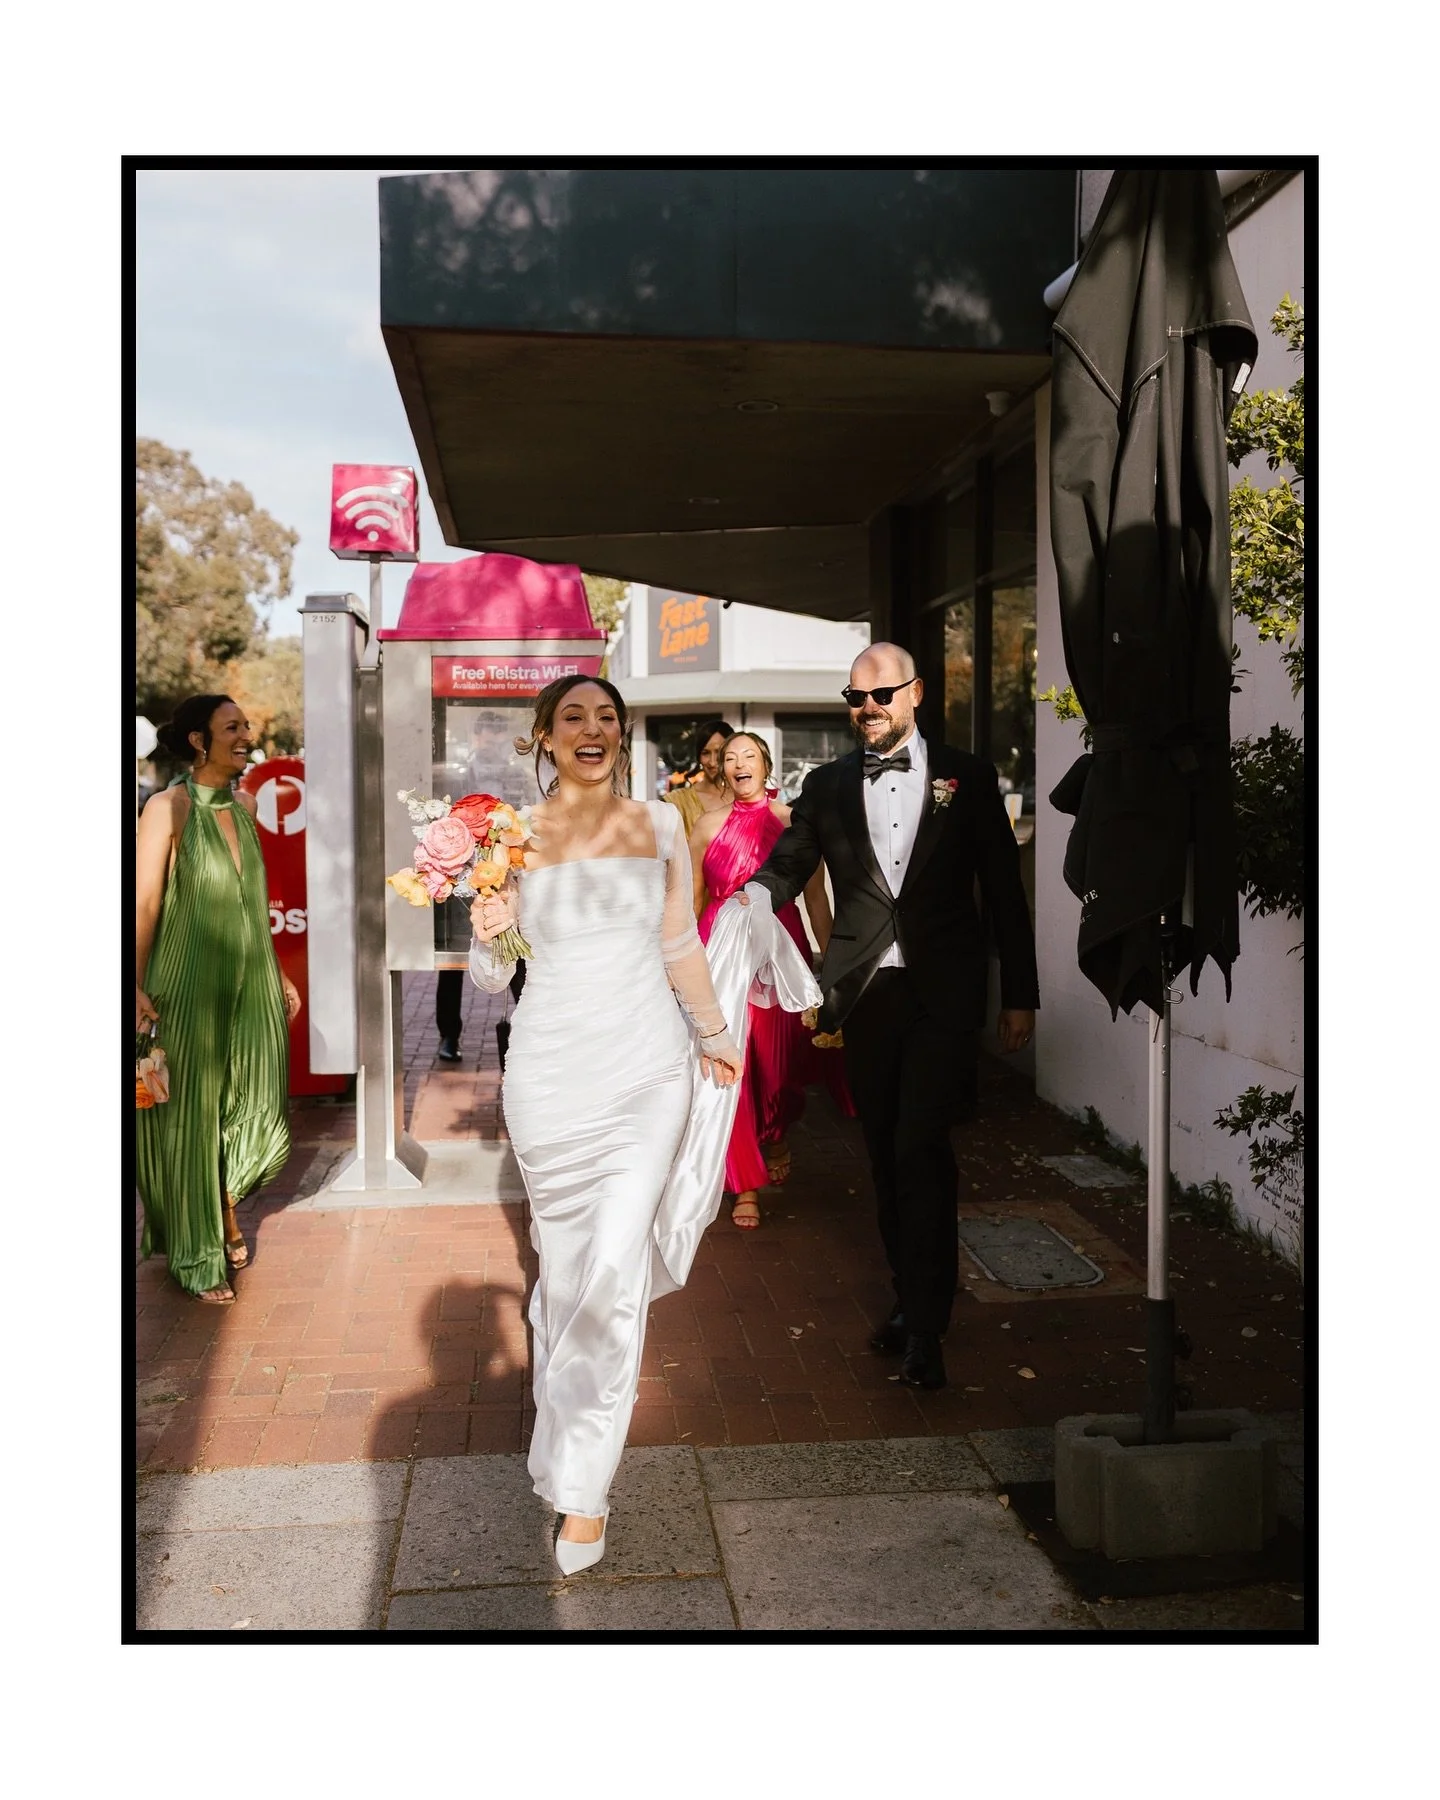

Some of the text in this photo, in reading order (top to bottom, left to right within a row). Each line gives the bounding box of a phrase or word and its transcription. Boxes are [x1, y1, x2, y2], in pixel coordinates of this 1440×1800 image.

[312, 615, 336, 623] 2152
[659, 595, 709, 631] Fast
[660, 621, 709, 657] Lane
[452, 665, 578, 680] Free Telstra Wi-Fi
[453, 682, 549, 692] Available here for everyo
[269, 908, 308, 935] os
